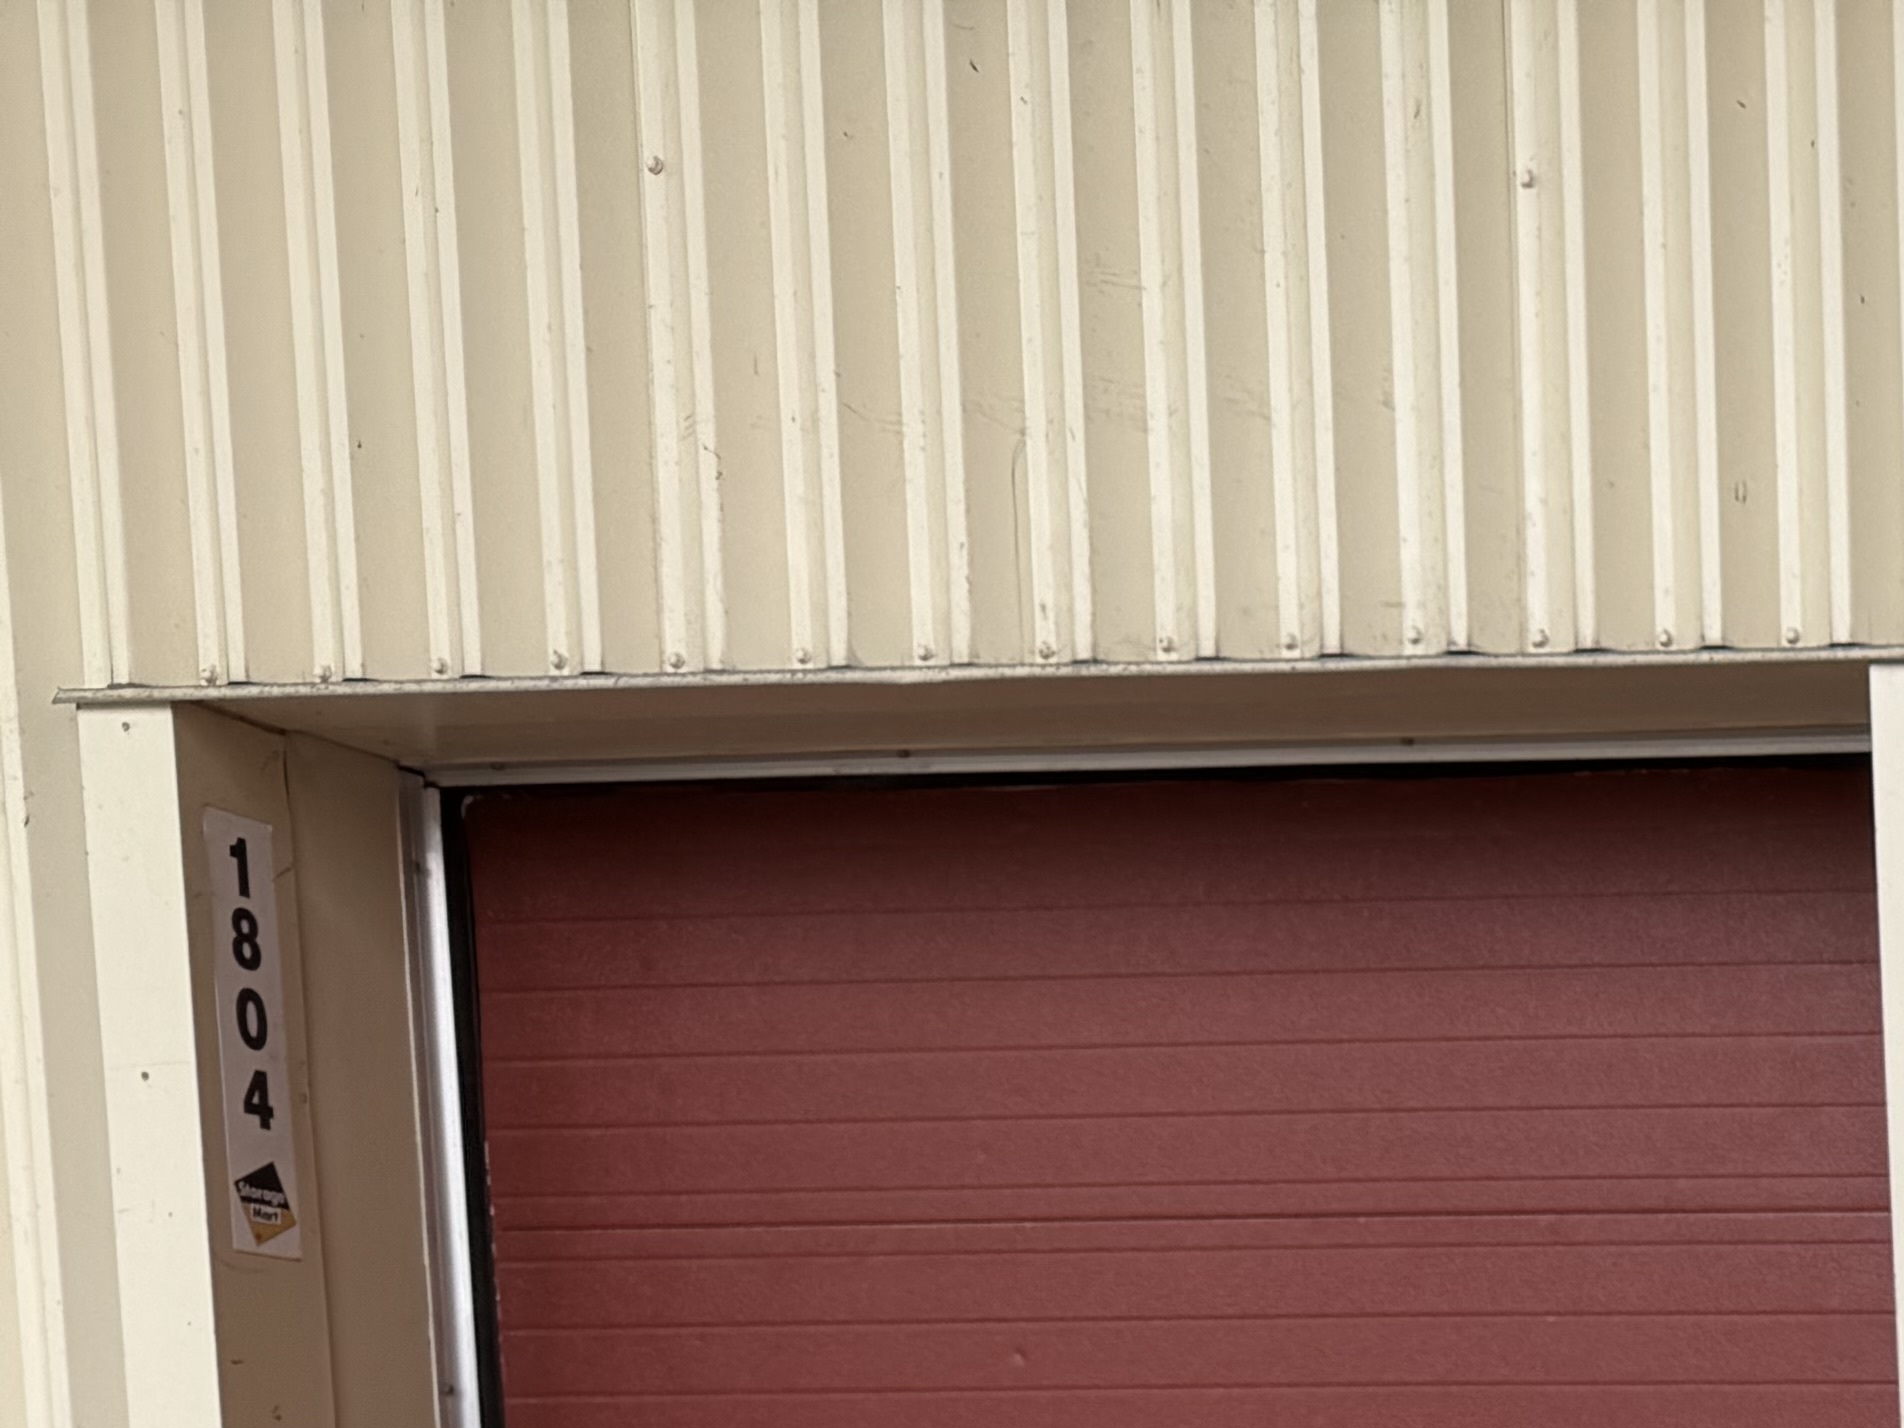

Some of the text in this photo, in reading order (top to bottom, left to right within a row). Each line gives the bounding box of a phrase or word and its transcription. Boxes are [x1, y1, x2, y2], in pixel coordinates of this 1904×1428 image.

[229, 837, 274, 1131] 1804
[238, 1180, 285, 1207] Storage
[252, 1206, 279, 1223] Mart
